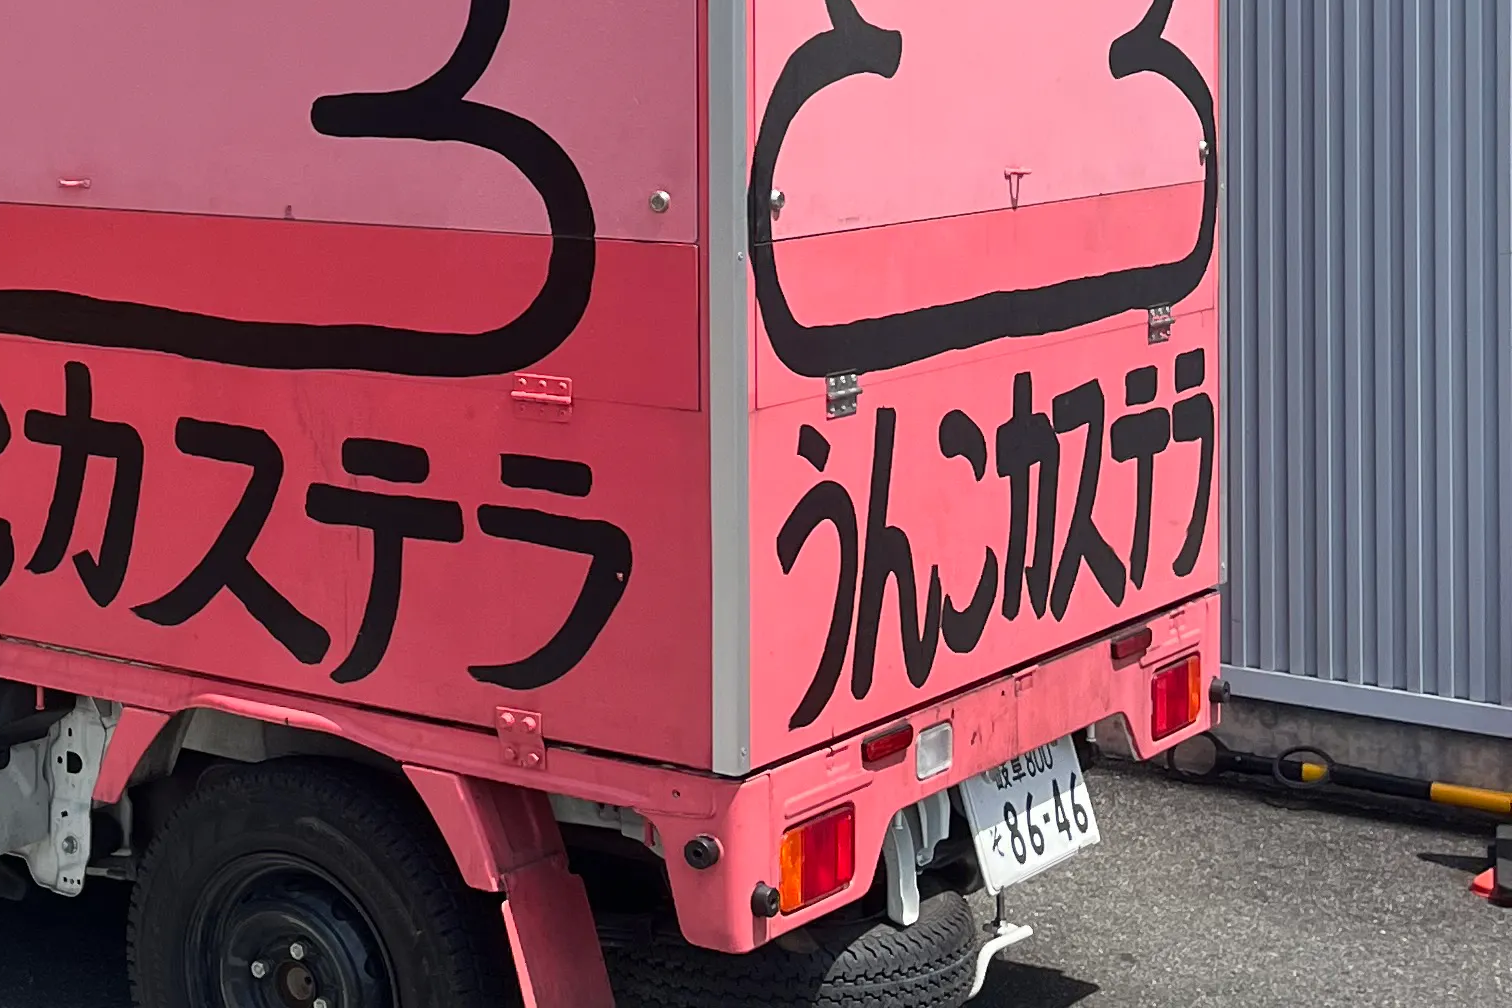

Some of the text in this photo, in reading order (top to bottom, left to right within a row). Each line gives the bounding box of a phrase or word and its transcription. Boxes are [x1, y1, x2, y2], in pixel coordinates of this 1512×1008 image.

[776, 348, 1215, 732] うんこカステラ
